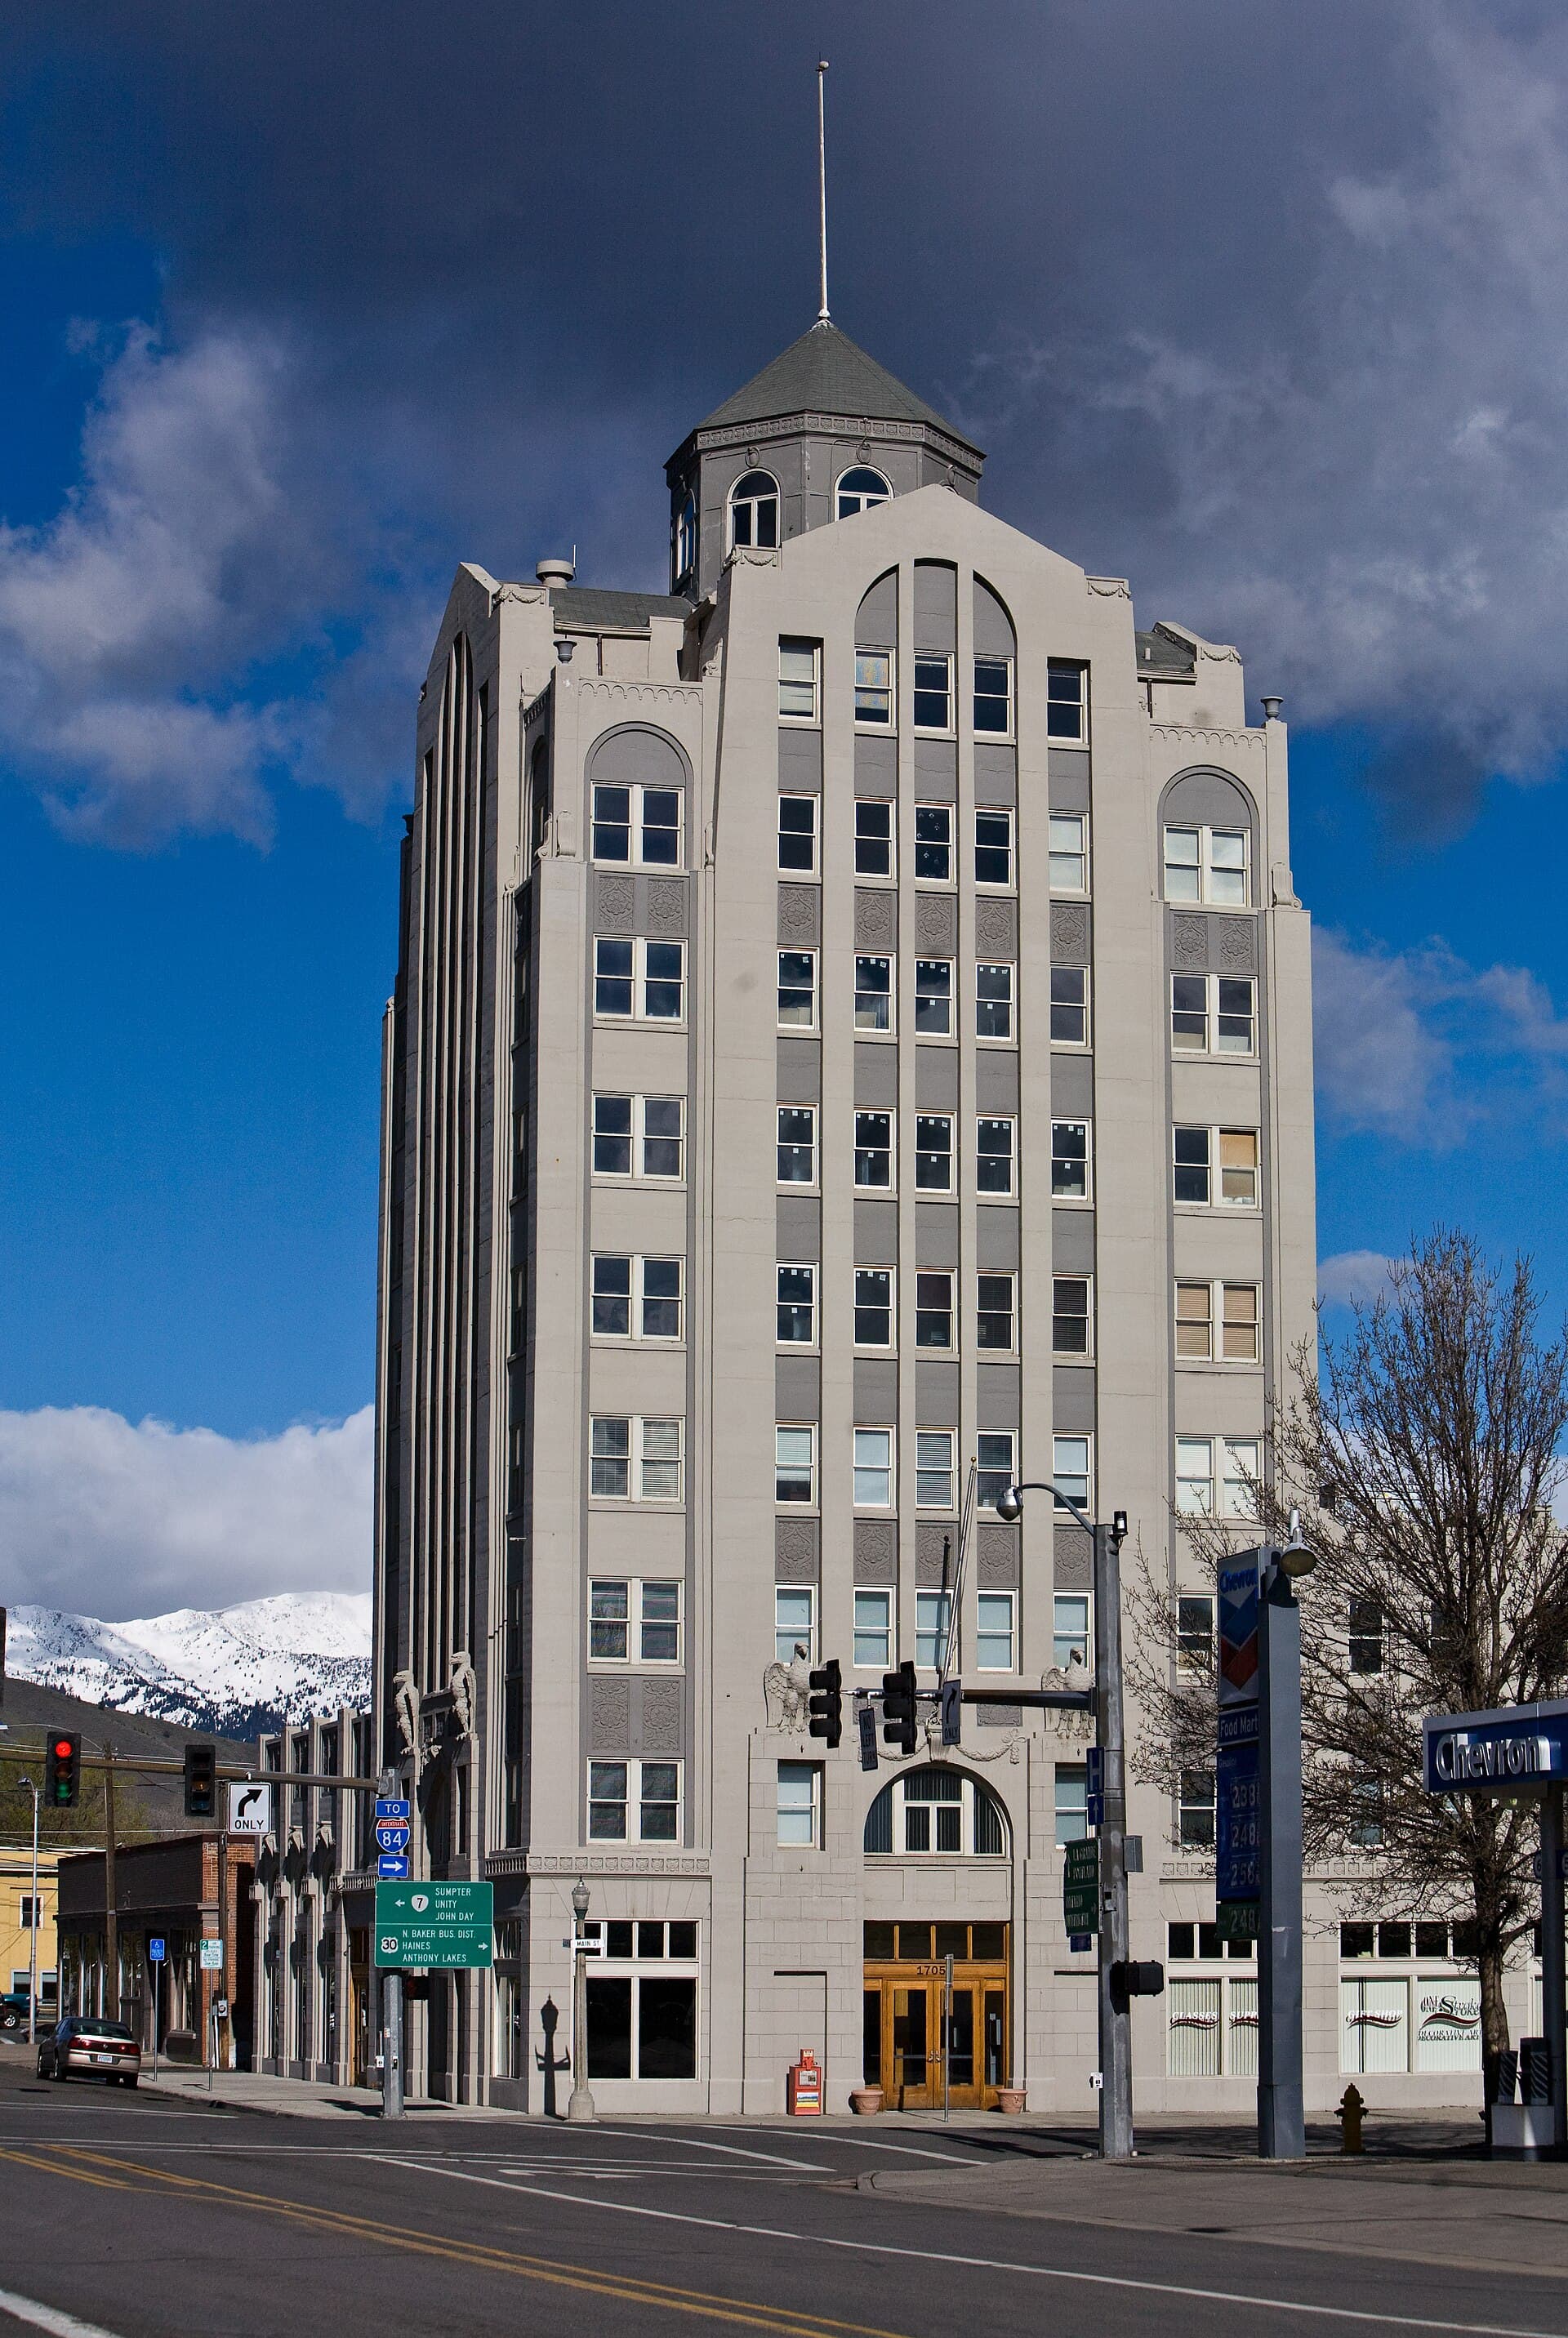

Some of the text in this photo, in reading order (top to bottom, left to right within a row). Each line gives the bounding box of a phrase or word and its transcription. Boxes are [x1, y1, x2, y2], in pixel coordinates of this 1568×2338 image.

[1220, 1568, 1258, 1593] Chevron
[863, 1714, 871, 1729] NO
[1220, 1712, 1258, 1738] Food Mart
[944, 1726, 958, 1739] ONLY
[863, 1733, 875, 1747] LEFT
[1436, 1733, 1551, 1781] Chevron
[1089, 1750, 1102, 1791] H
[385, 1804, 399, 1814] TO
[235, 1820, 264, 1830] ONLY
[382, 1831, 402, 1846] 84
[435, 1887, 471, 1896] SUMPTER
[416, 1897, 423, 1908] 7
[435, 1900, 457, 1908] UNITY
[435, 1913, 474, 1921] JOHN DAY
[403, 1930, 475, 1939] N. BAKER BUS. DIST.
[202, 1941, 207, 1949] 2
[382, 1939, 396, 1950] 30
[403, 1942, 430, 1950] HAINES
[403, 1953, 467, 1962] ANTHONY LAKES
[916, 1966, 946, 1975] 1705
[1422, 1995, 1439, 2011] ONE
[1171, 2011, 1218, 2021] CLASSES
[1375, 2010, 1402, 2020] SHOP
